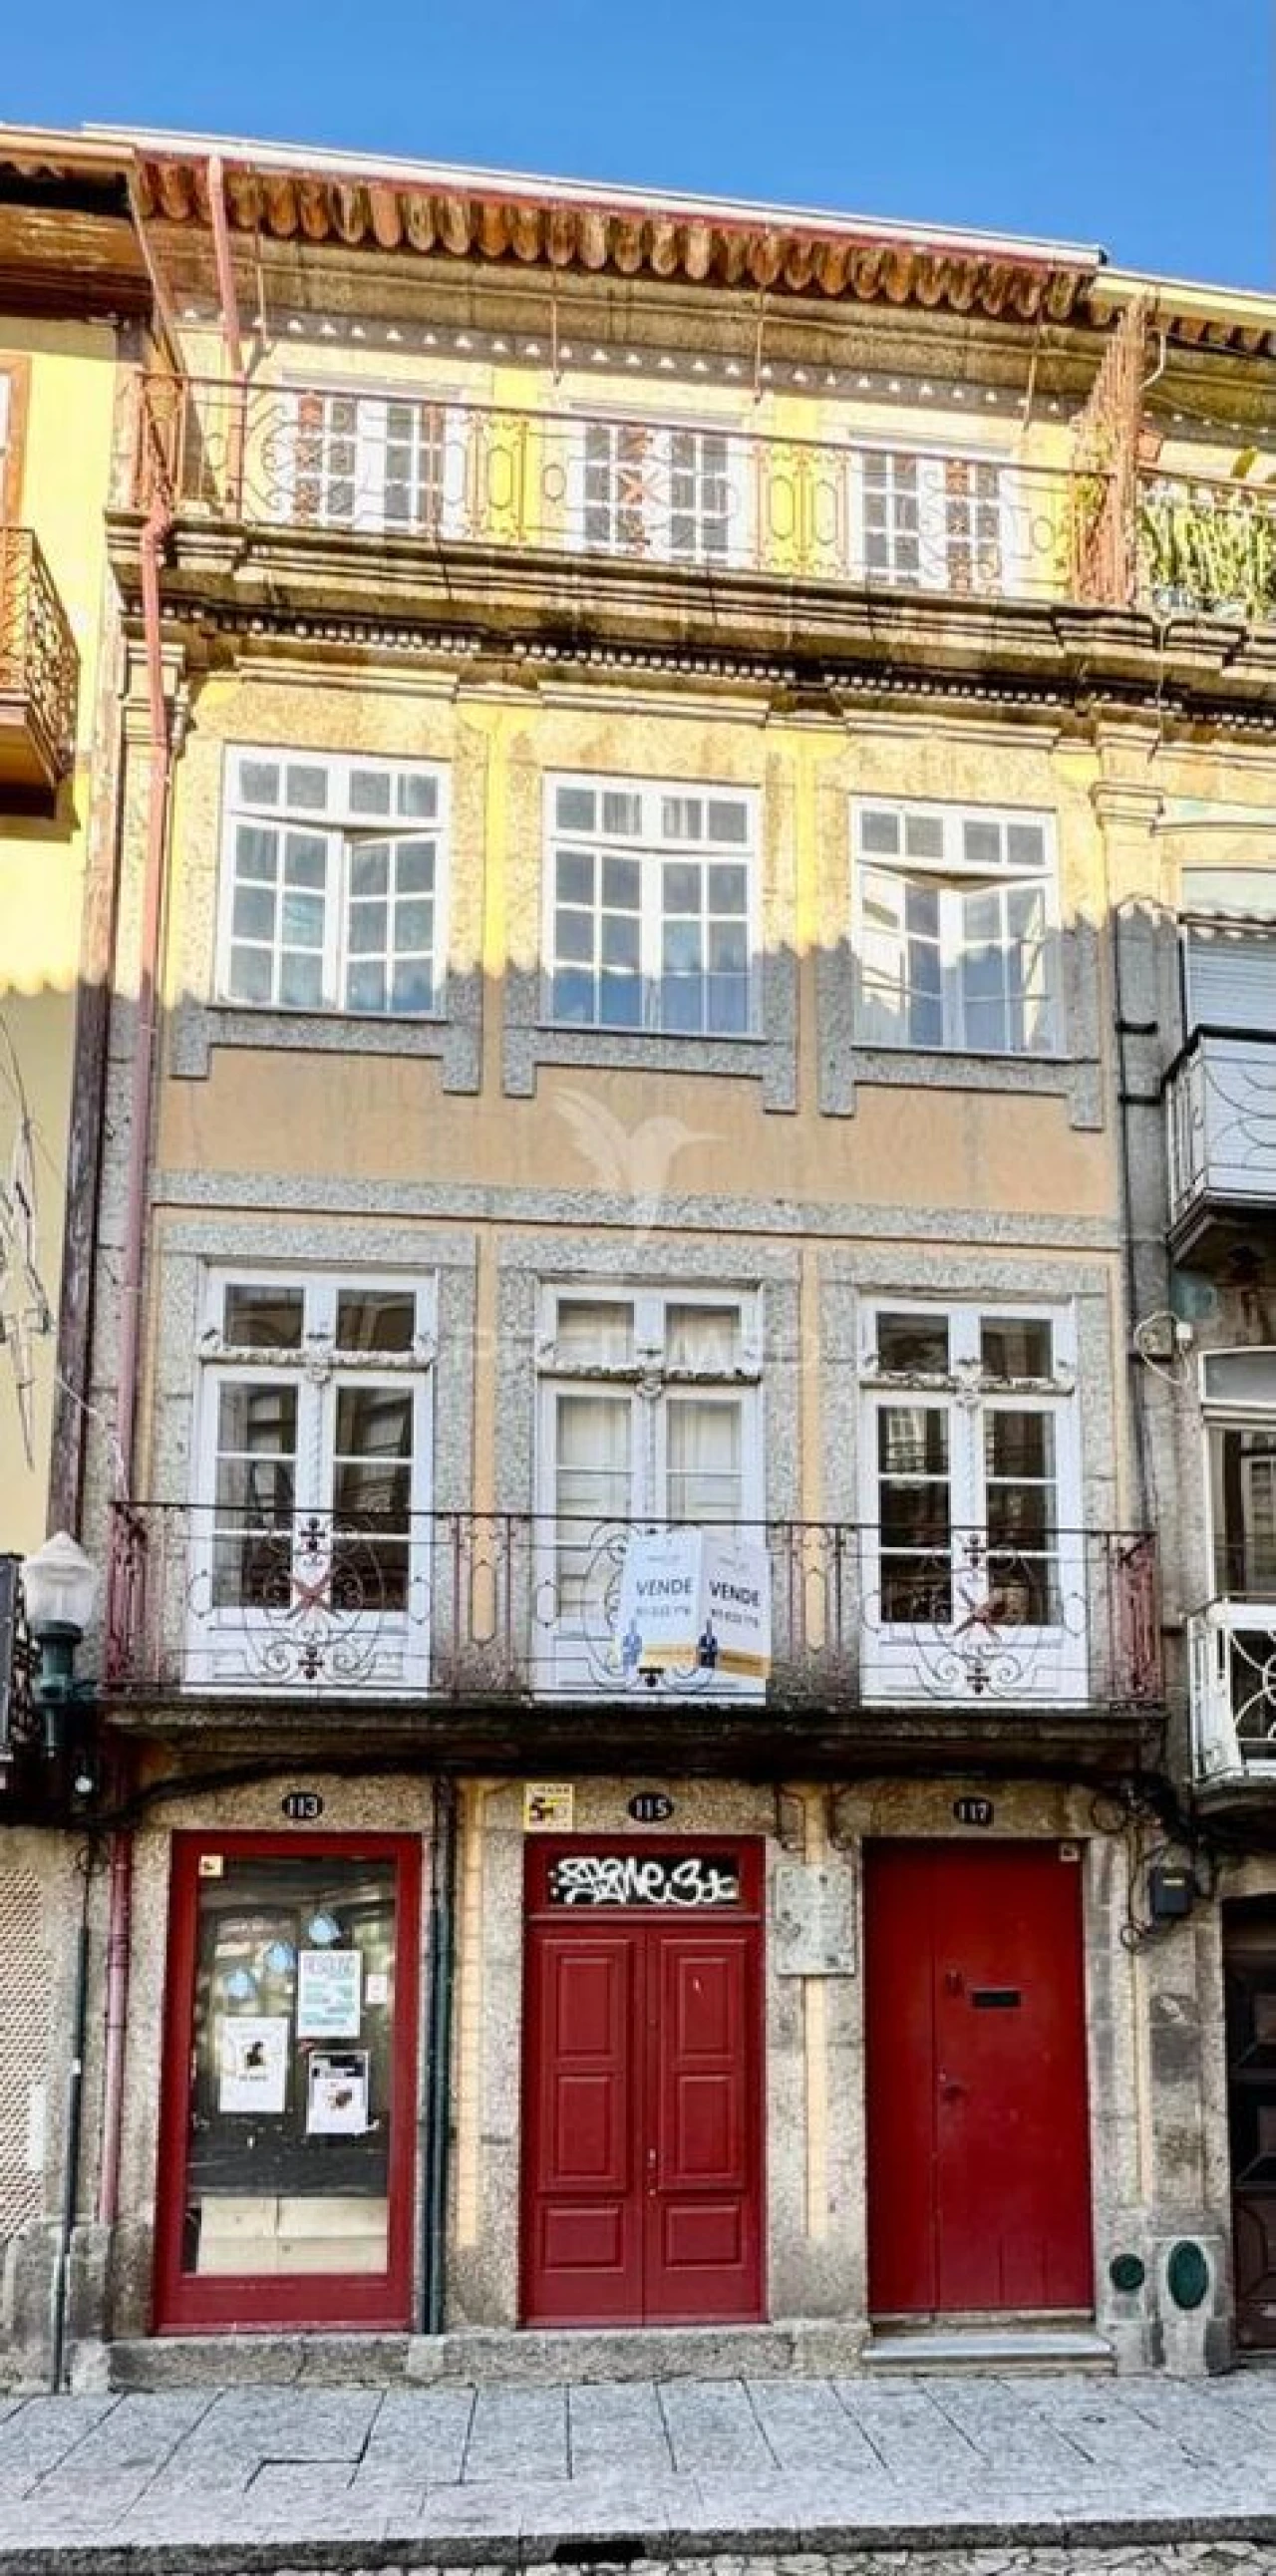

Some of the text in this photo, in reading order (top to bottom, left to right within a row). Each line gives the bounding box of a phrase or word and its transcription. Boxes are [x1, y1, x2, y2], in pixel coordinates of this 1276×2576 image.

[636, 1577, 692, 1596] VENDE
[709, 1579, 760, 1607] VENDE
[289, 1796, 318, 1816] 113
[636, 1798, 667, 1817] 115
[959, 1802, 987, 1820] 117
